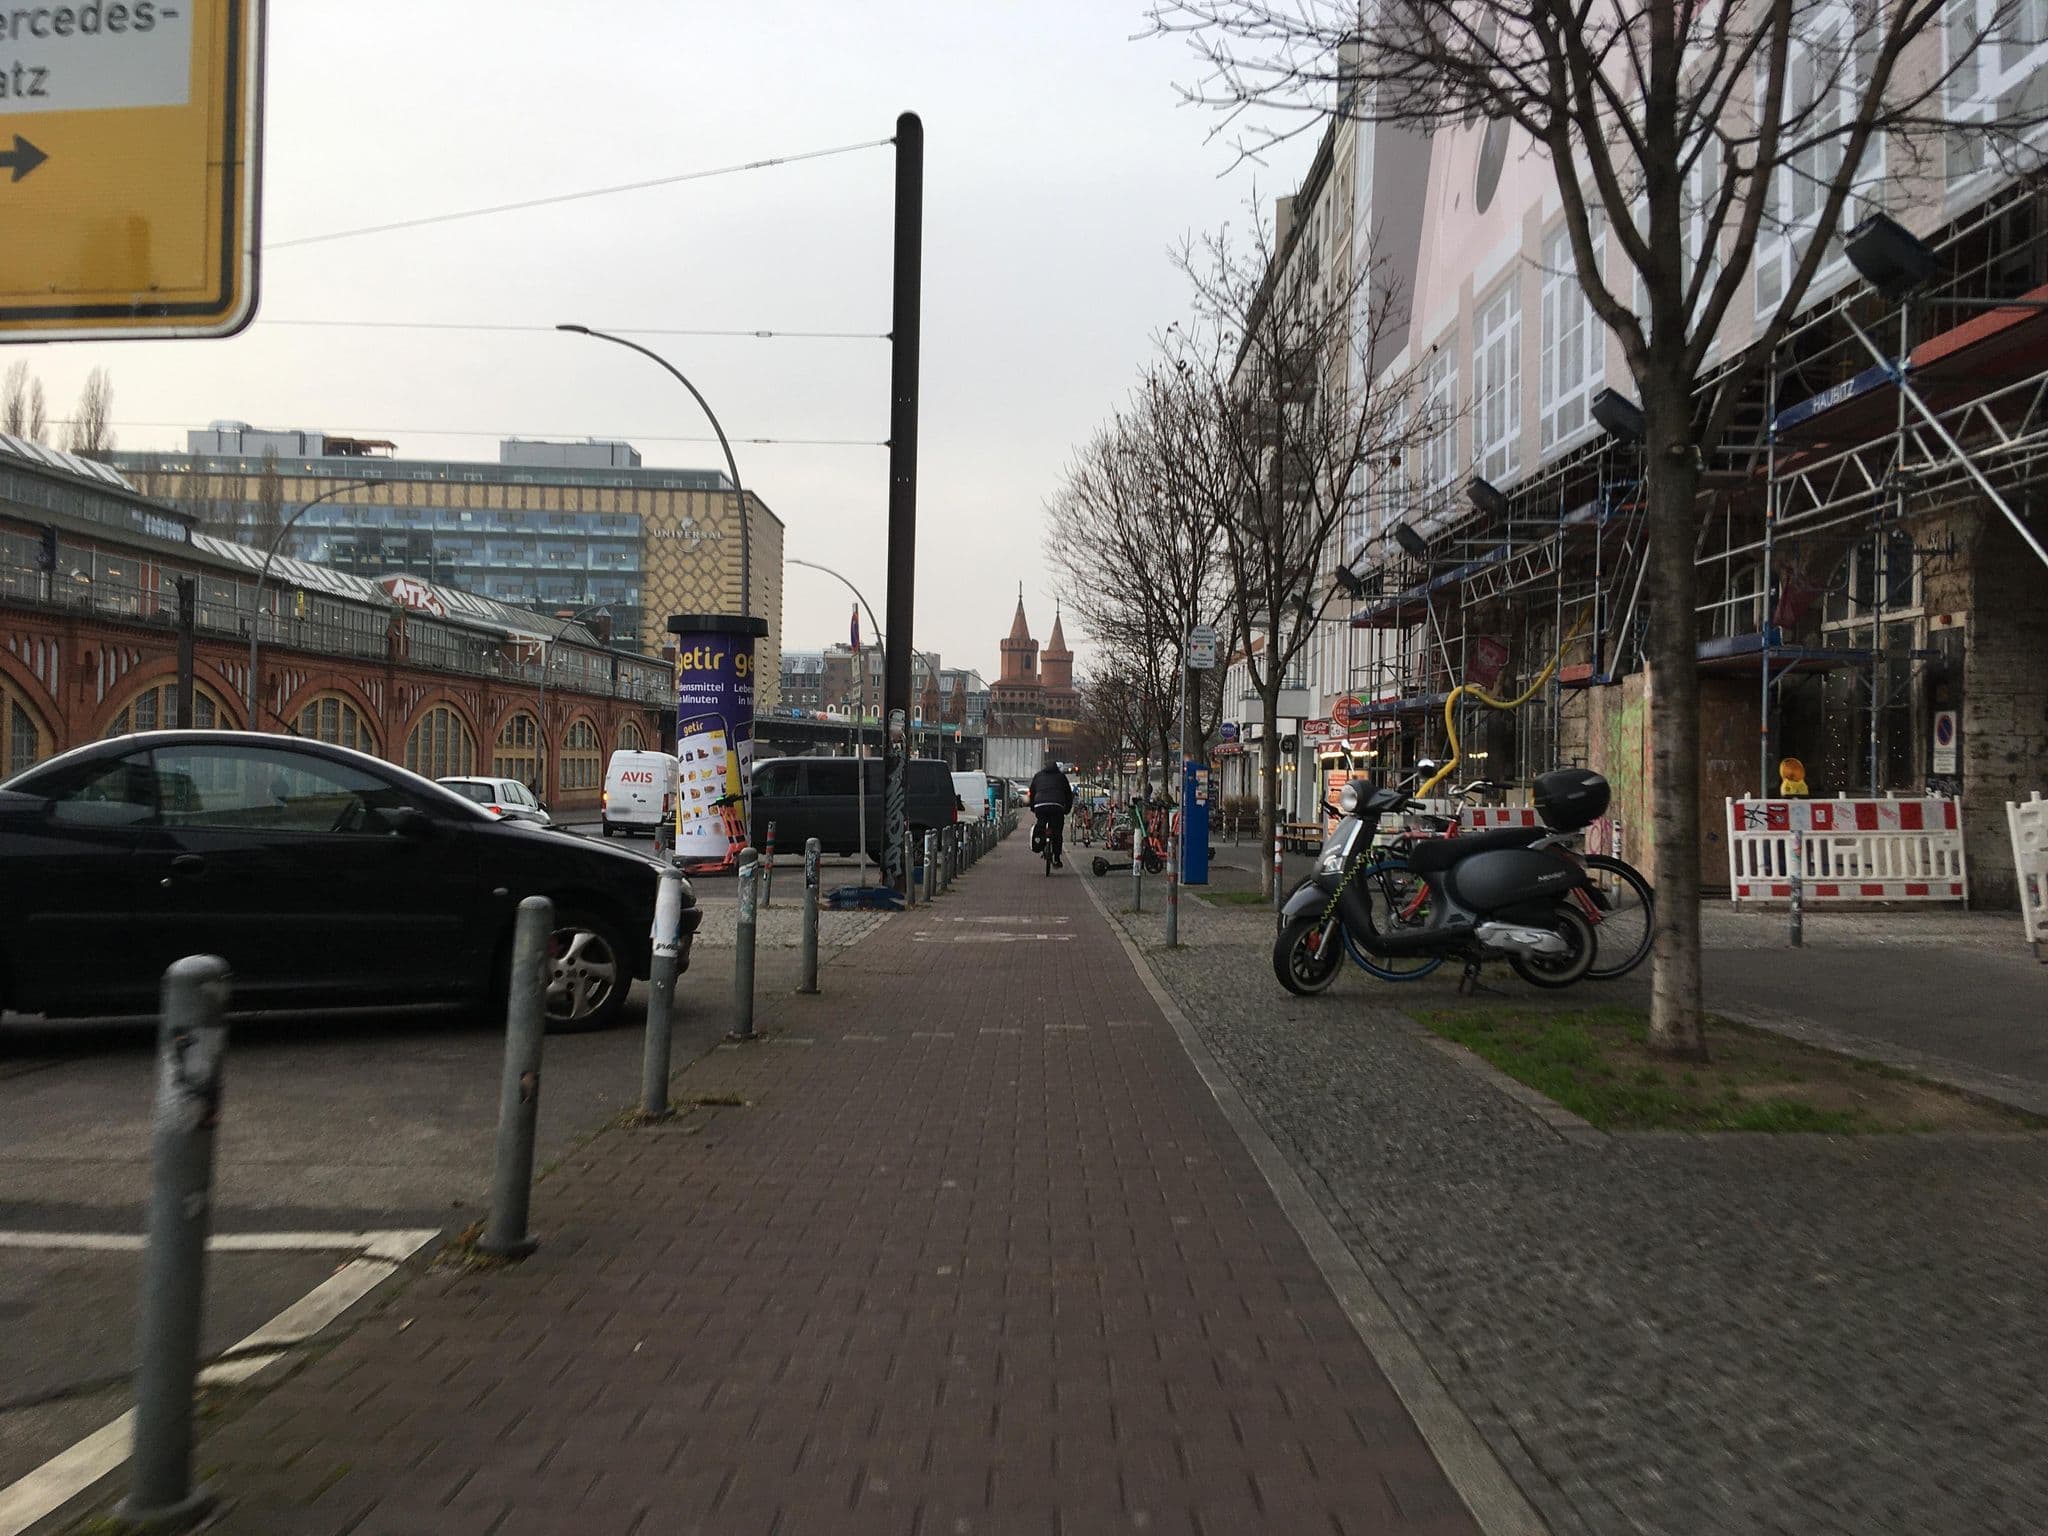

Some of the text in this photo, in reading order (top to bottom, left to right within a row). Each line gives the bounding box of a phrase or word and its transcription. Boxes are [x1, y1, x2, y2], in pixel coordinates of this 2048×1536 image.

[653, 527, 725, 540] UNIVERSAL
[683, 721, 703, 737] getir
[621, 771, 653, 783] AVIS
